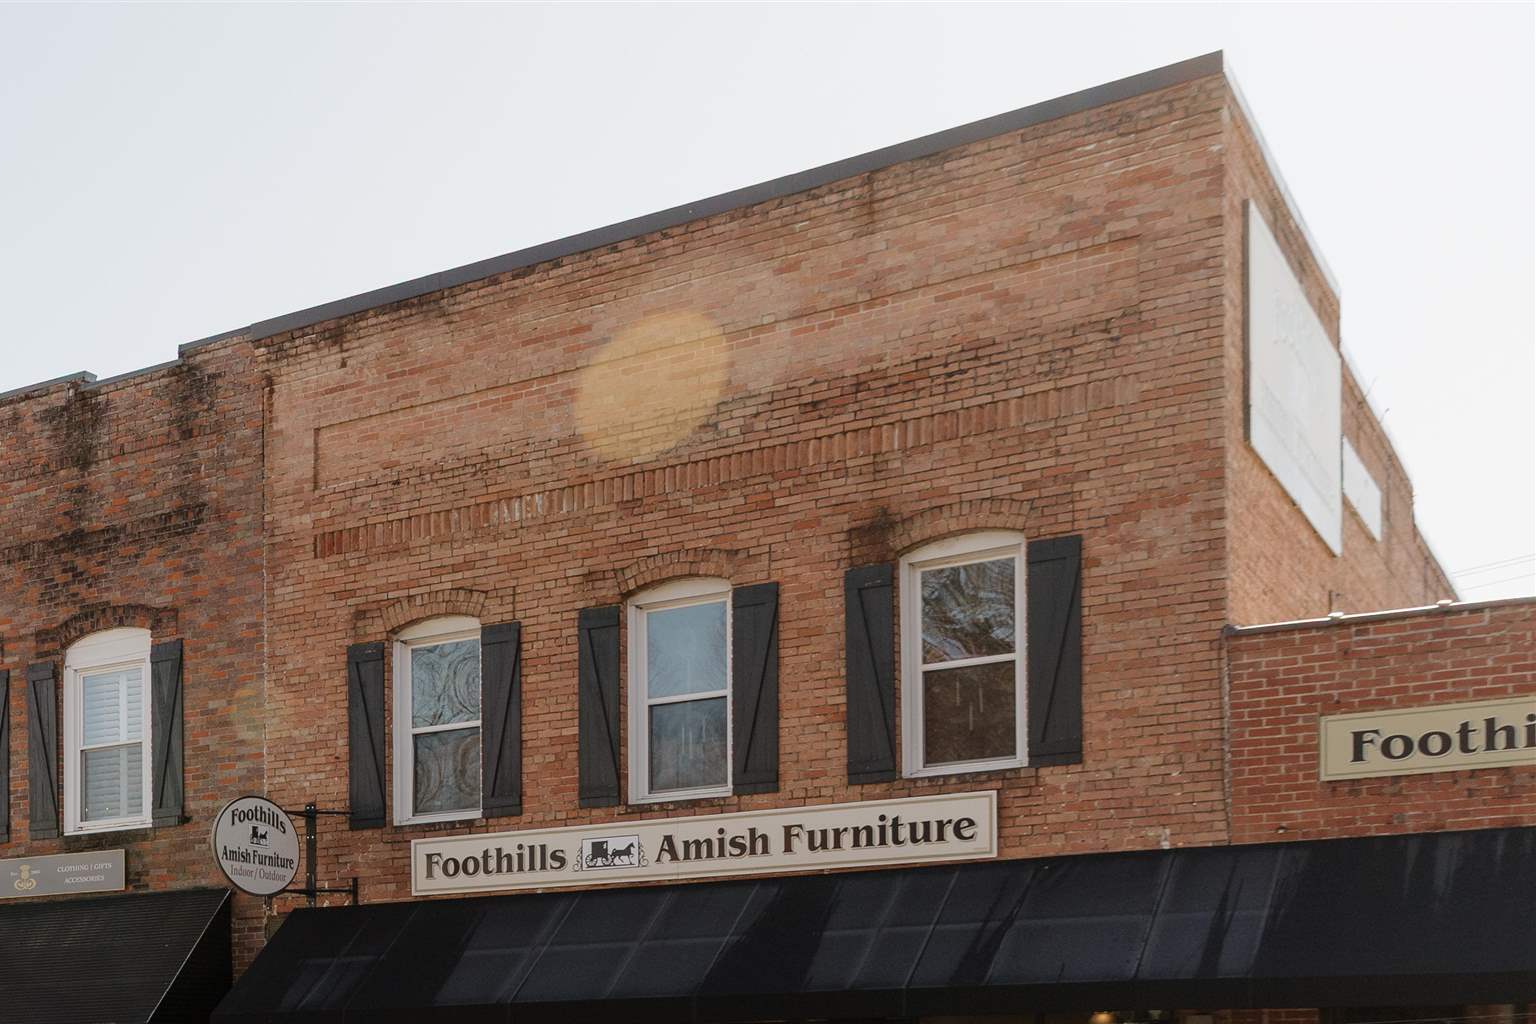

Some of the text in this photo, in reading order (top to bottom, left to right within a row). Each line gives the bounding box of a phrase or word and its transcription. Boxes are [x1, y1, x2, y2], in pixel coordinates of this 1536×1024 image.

[1350, 713, 1536, 763] Foothi
[231, 805, 286, 834] Foothills
[221, 845, 295, 870] Amish Furniture
[425, 814, 978, 880] Foothills Amish Furniture
[230, 865, 254, 879] Indoor
[259, 869, 287, 882] Outdoor
